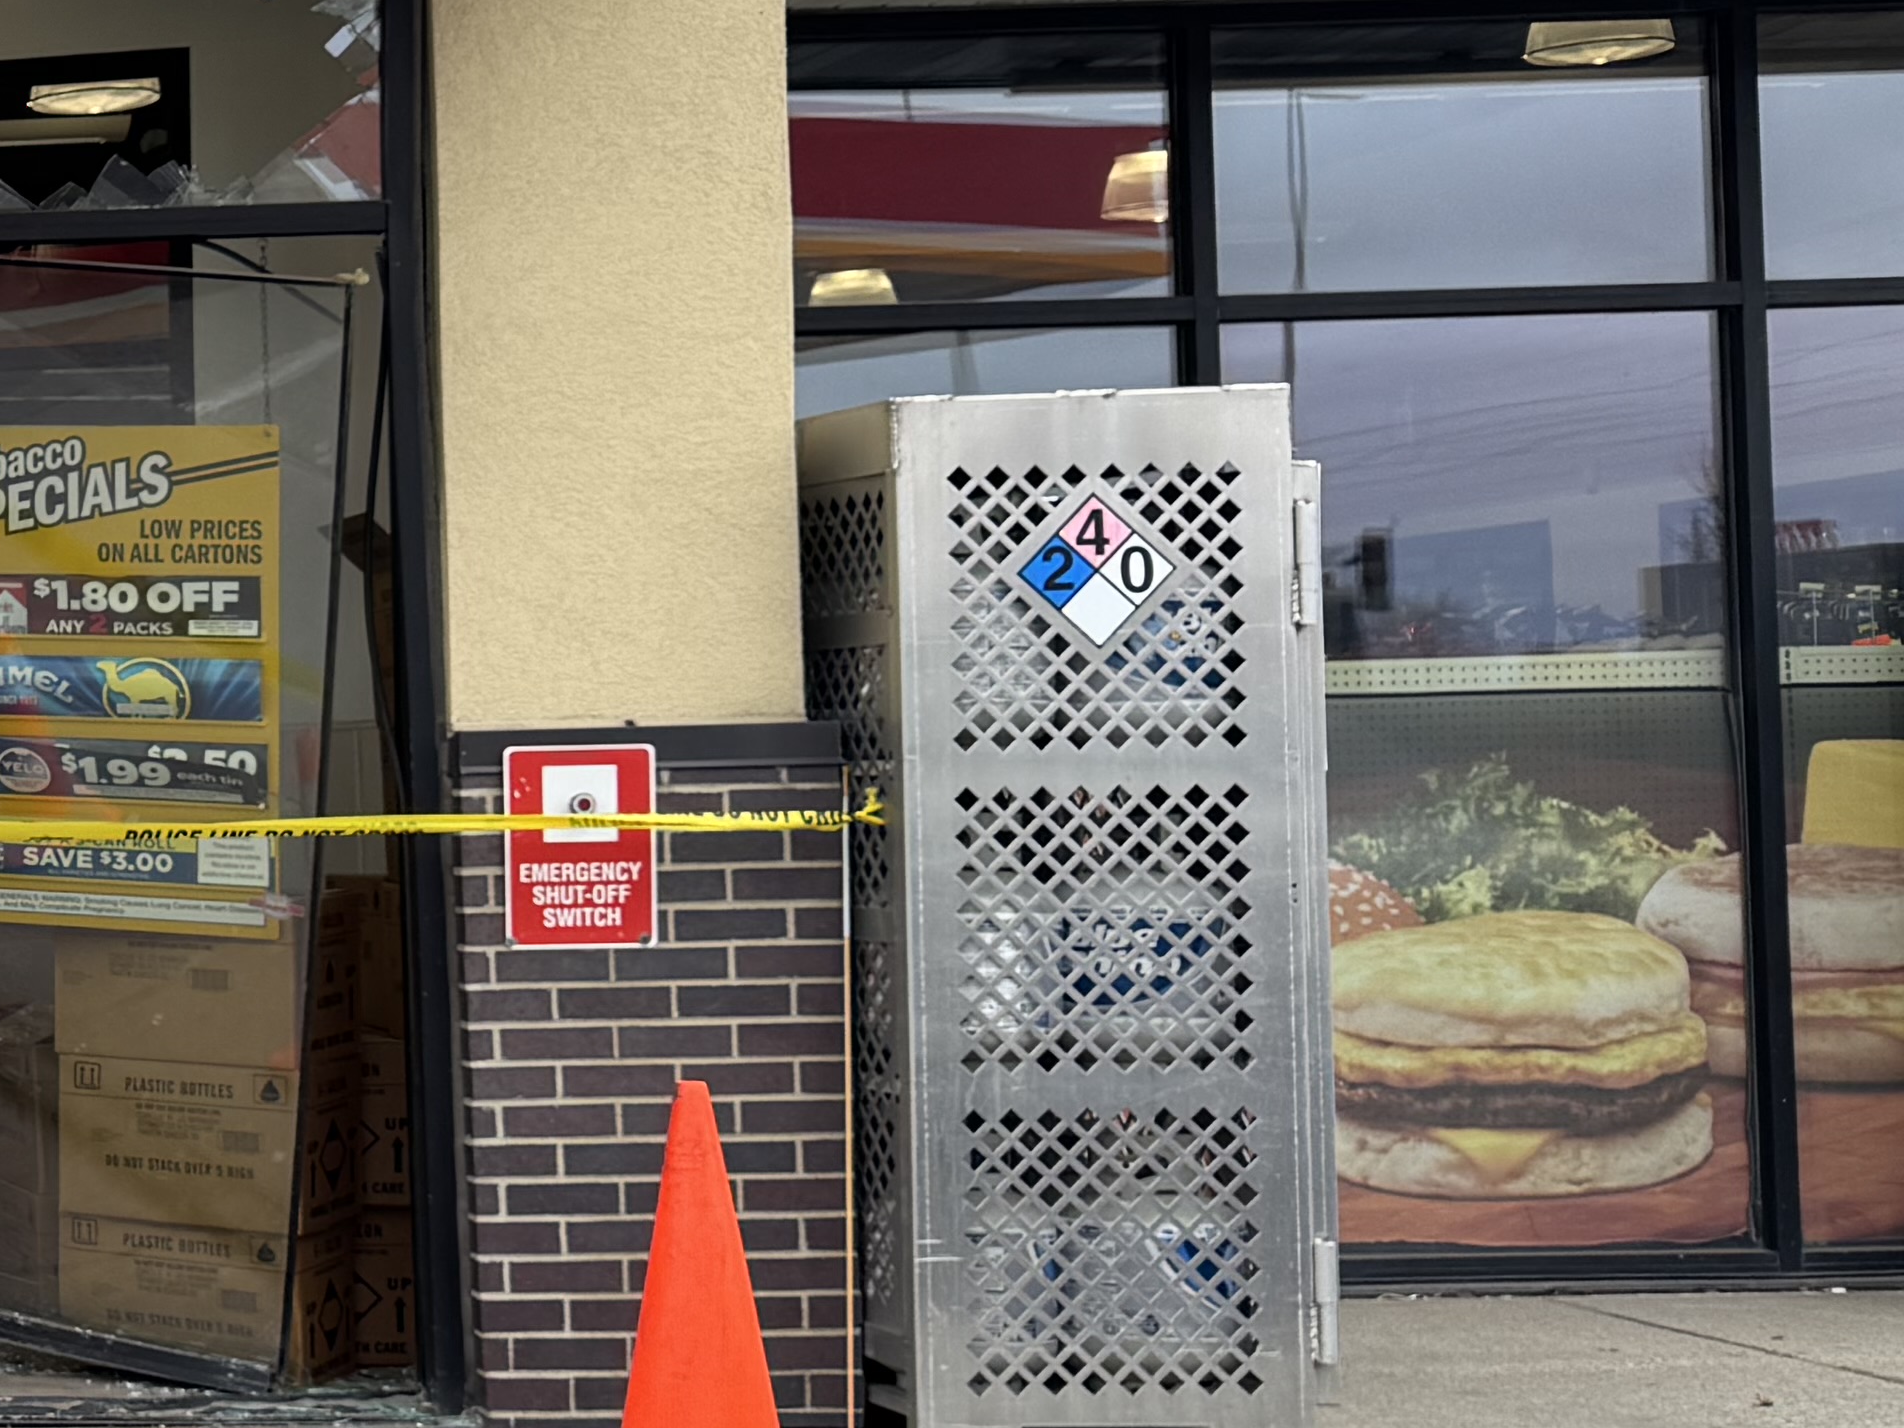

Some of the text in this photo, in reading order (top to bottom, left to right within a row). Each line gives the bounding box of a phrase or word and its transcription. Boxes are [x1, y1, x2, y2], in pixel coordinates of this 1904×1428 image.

[140, 520, 263, 541] LOW PRICES
[1075, 508, 1111, 556] 4
[98, 543, 263, 565] ON ALL CARTONS
[1041, 545, 1154, 593] 2 0
[33, 577, 240, 613] $1.80 OFF
[45, 615, 173, 635] ANY 2 PACKS
[62, 753, 171, 787] $1.99
[23, 848, 174, 873] SAVE $3.00
[519, 861, 642, 883] EMERGENCY
[532, 884, 632, 907] SHUT-OFF
[542, 907, 622, 928] SWITCH
[124, 1076, 234, 1100] PLASTIC BOTTLES
[123, 1233, 231, 1258] PLASTIC BOTTLES
